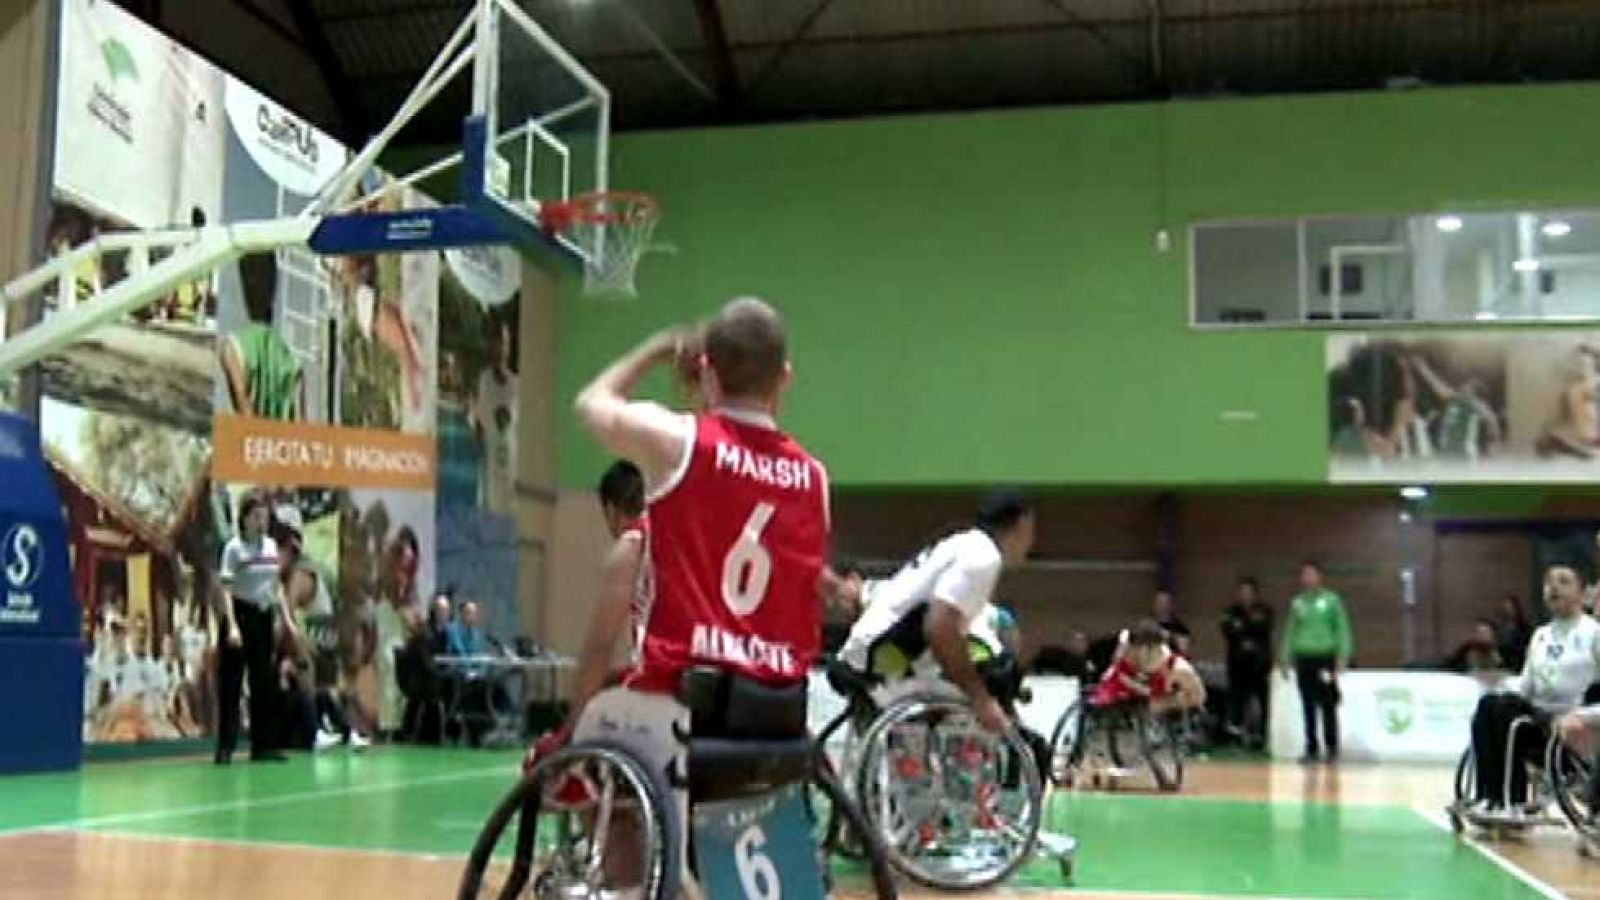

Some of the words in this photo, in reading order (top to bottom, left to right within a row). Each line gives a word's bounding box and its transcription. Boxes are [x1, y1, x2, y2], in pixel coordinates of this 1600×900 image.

[716, 441, 810, 490] MARSH
[722, 502, 776, 616] 6
[734, 824, 783, 900] 6
